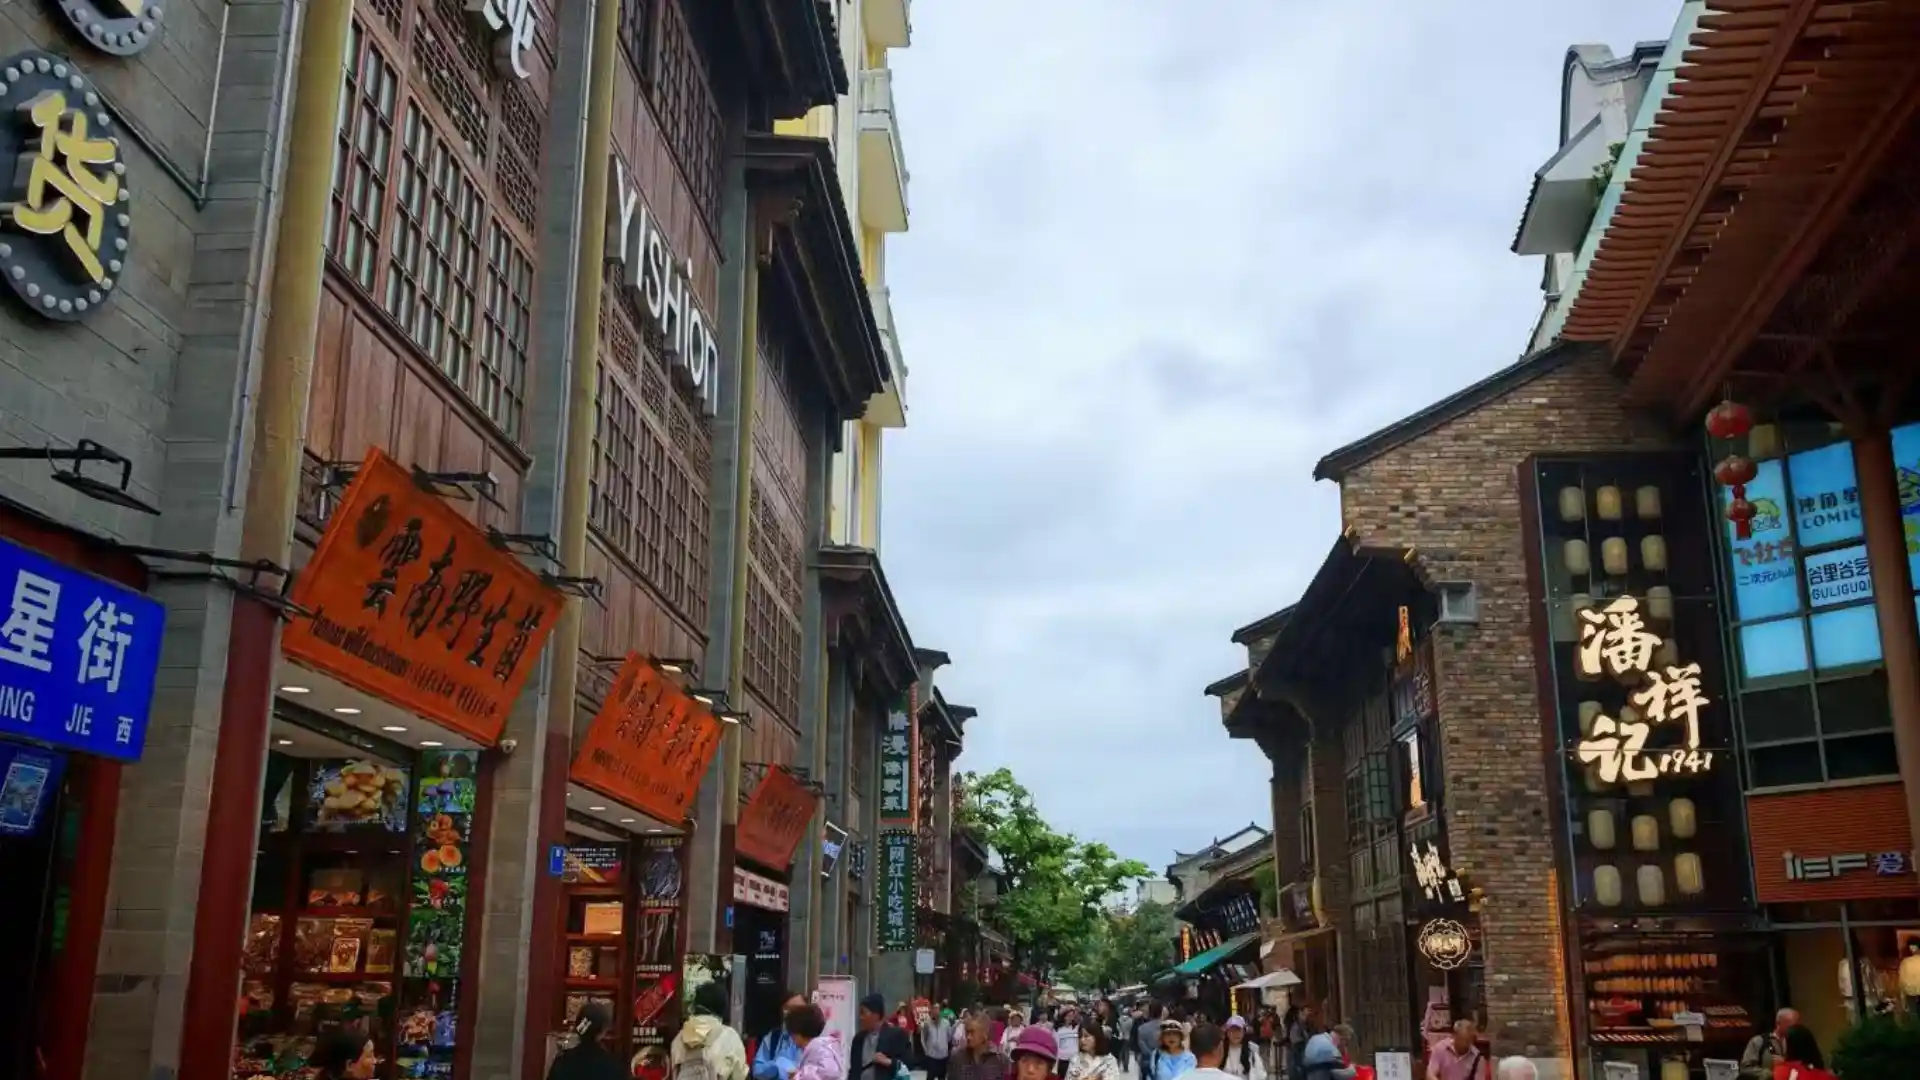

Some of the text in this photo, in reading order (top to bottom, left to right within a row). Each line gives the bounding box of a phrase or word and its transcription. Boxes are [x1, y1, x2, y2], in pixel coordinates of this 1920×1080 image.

[0, 569, 134, 693] 星街
[65, 702, 93, 737] JIE
[1577, 594, 1711, 783] 潘祥记
[1659, 748, 1713, 774] 1941
